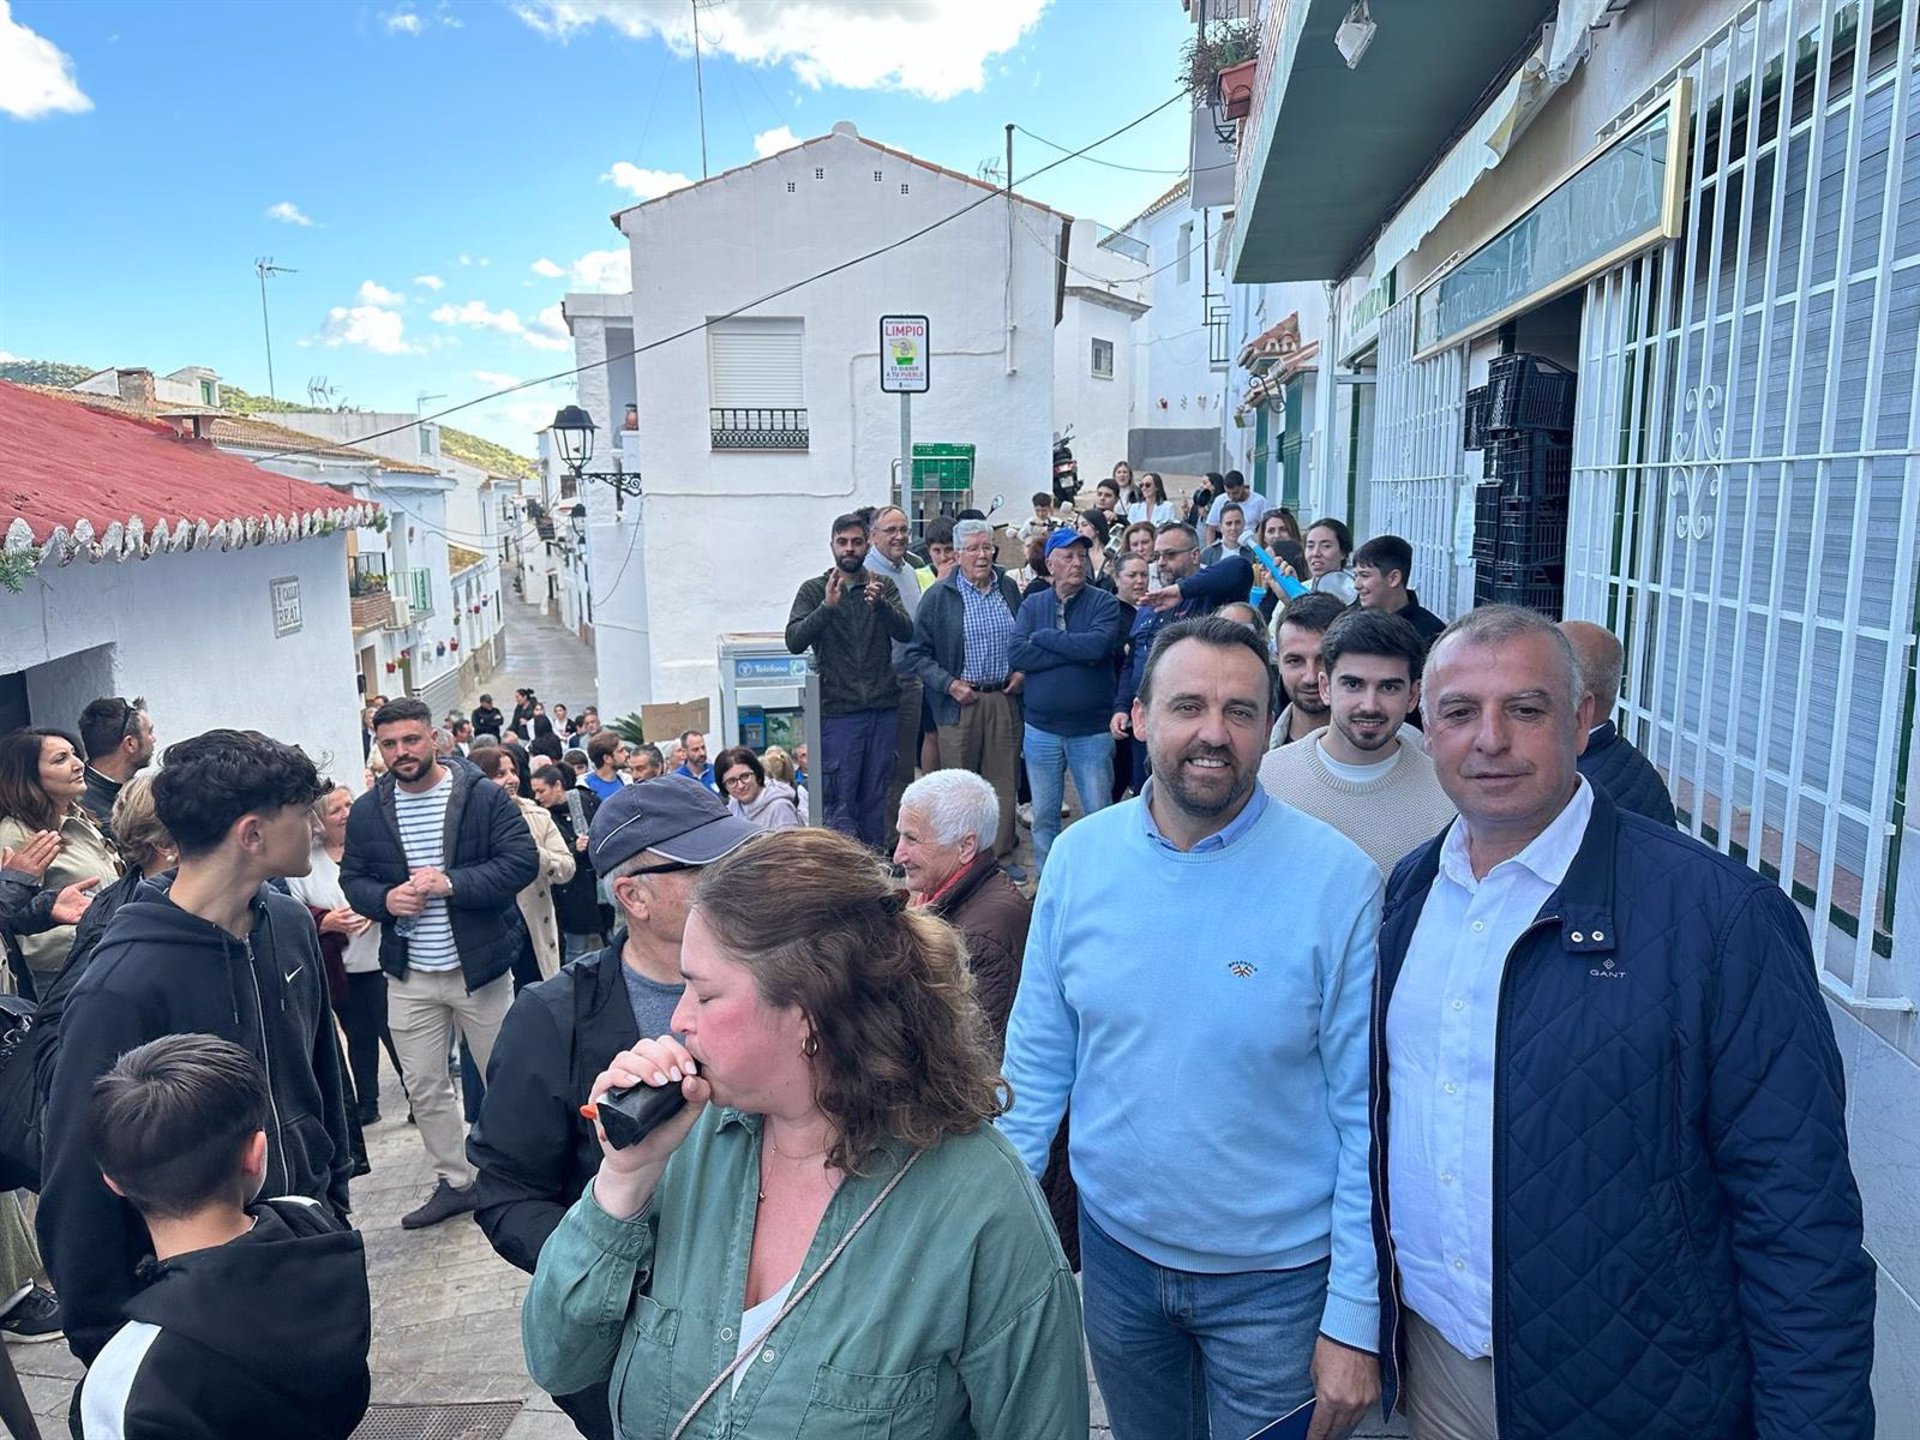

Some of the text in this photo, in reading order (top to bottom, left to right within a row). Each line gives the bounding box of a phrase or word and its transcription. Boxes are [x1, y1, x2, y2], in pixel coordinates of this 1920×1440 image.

[1505, 220, 1534, 300] LA
[885, 326, 924, 337] LIMPIO
[1589, 969, 1626, 978] GANT
